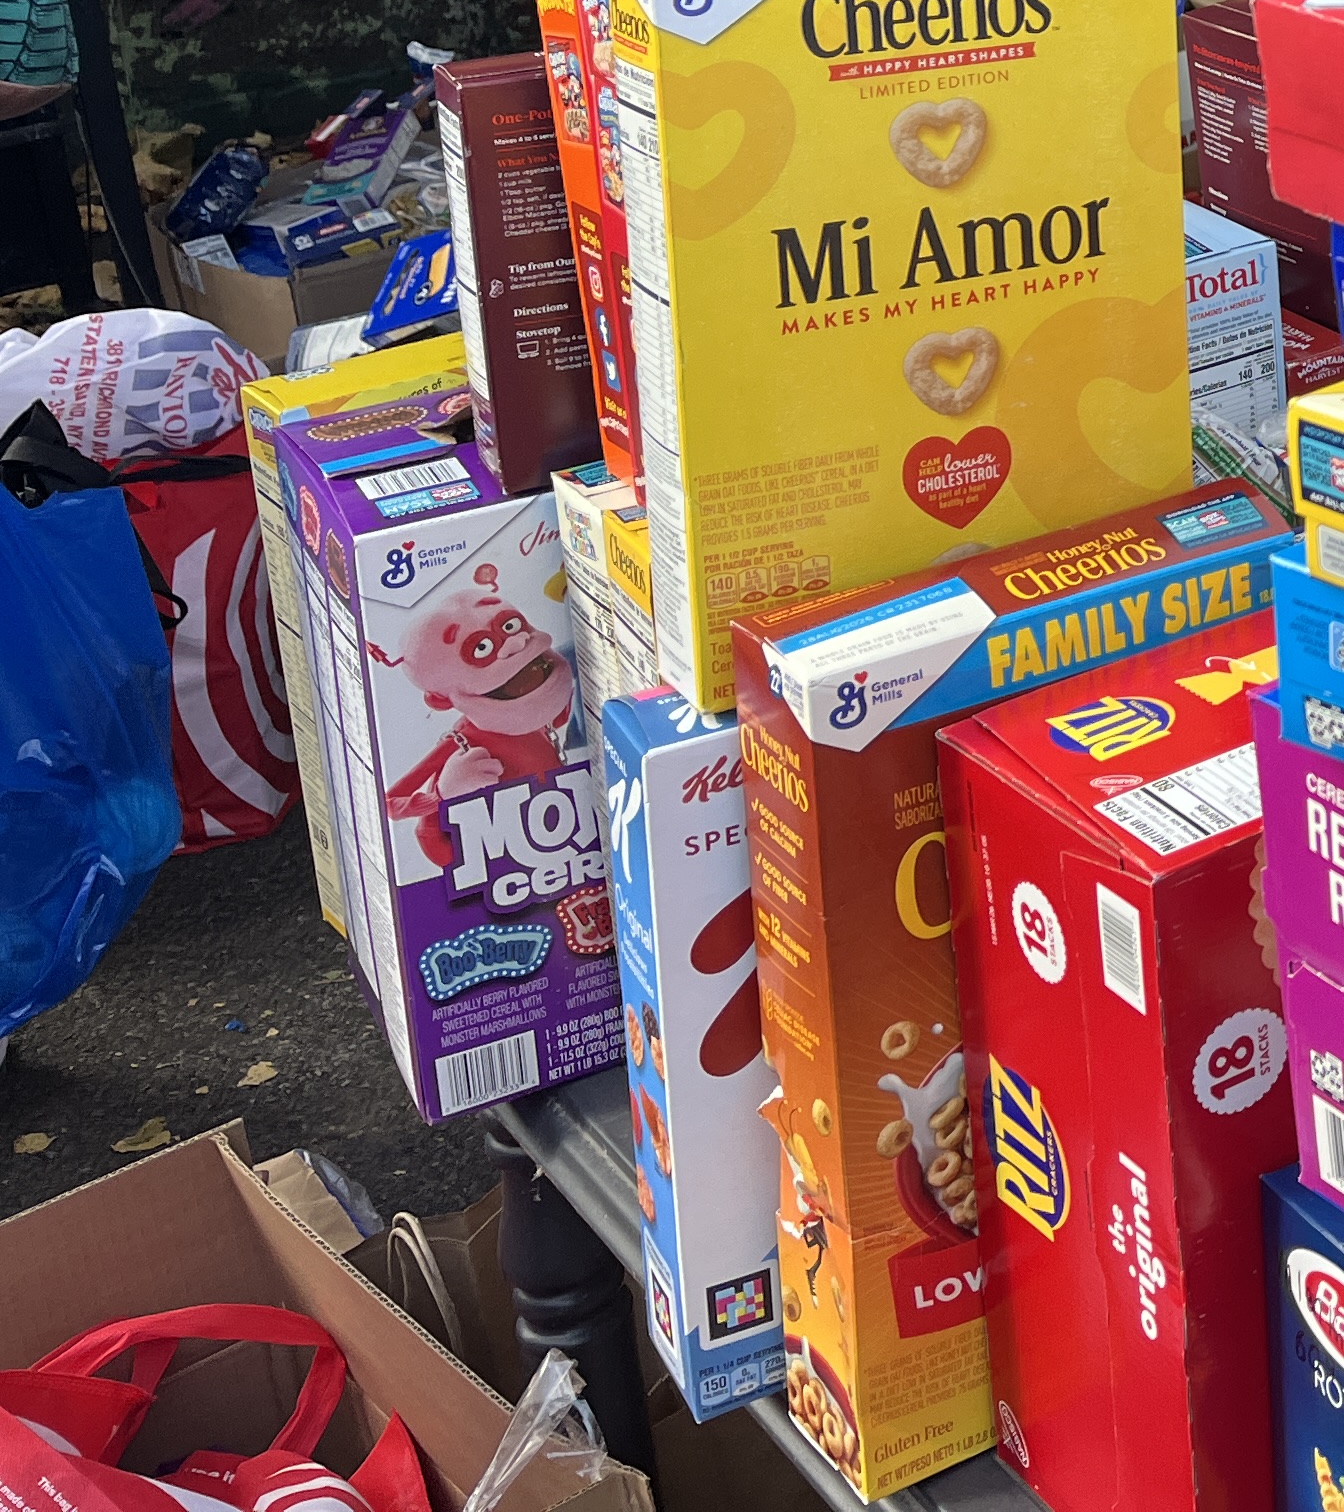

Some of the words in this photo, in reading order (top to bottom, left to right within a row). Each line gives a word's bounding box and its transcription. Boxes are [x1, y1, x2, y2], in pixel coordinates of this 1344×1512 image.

[859, 77, 939, 99] LIMITED
[942, 68, 1011, 91] EDITION
[863, 58, 914, 76] HAPPY
[917, 51, 966, 70] HEART
[968, 45, 1026, 64] SHAPES
[771, 216, 879, 311] Mi
[899, 197, 1110, 291] Amor
[781, 307, 870, 336] MAKES
[884, 299, 917, 319] MY
[931, 284, 1010, 311] HEART
[1024, 267, 1101, 294] HAPPY
[1186, 258, 1260, 305] Total
[512, 301, 570, 318] Directions
[515, 324, 562, 340] Stovetop
[1304, 365, 1342, 384] HARVEST
[416, 540, 467, 561] General
[418, 555, 449, 570] Mills
[1003, 537, 1168, 602] Cheerios
[1046, 533, 1107, 563] Honey
[1103, 526, 1139, 548] Nut
[985, 592, 1152, 689] FAMILY
[1160, 561, 1254, 635] SIZE
[871, 669, 924, 694] General
[872, 687, 904, 705] Mills
[1045, 694, 1174, 762] RITZ
[740, 721, 810, 814] Cheerios
[1018, 901, 1048, 959] 18
[1046, 915, 1061, 969] STACKS
[1206, 1034, 1257, 1101] 18
[1256, 1021, 1272, 1078] STACKS
[987, 1053, 1055, 1243] RITZ
[1106, 1202, 1128, 1253] the
[1119, 1151, 1168, 1343] original
[874, 1432, 921, 1464] Gluten
[923, 1420, 954, 1442] Free
[877, 1470, 893, 1490] NET
[894, 1452, 933, 1482] WT/PESO
[932, 1442, 955, 1464] NETO
[962, 1434, 975, 1451] LB
[36, 1475, 56, 1497] This
